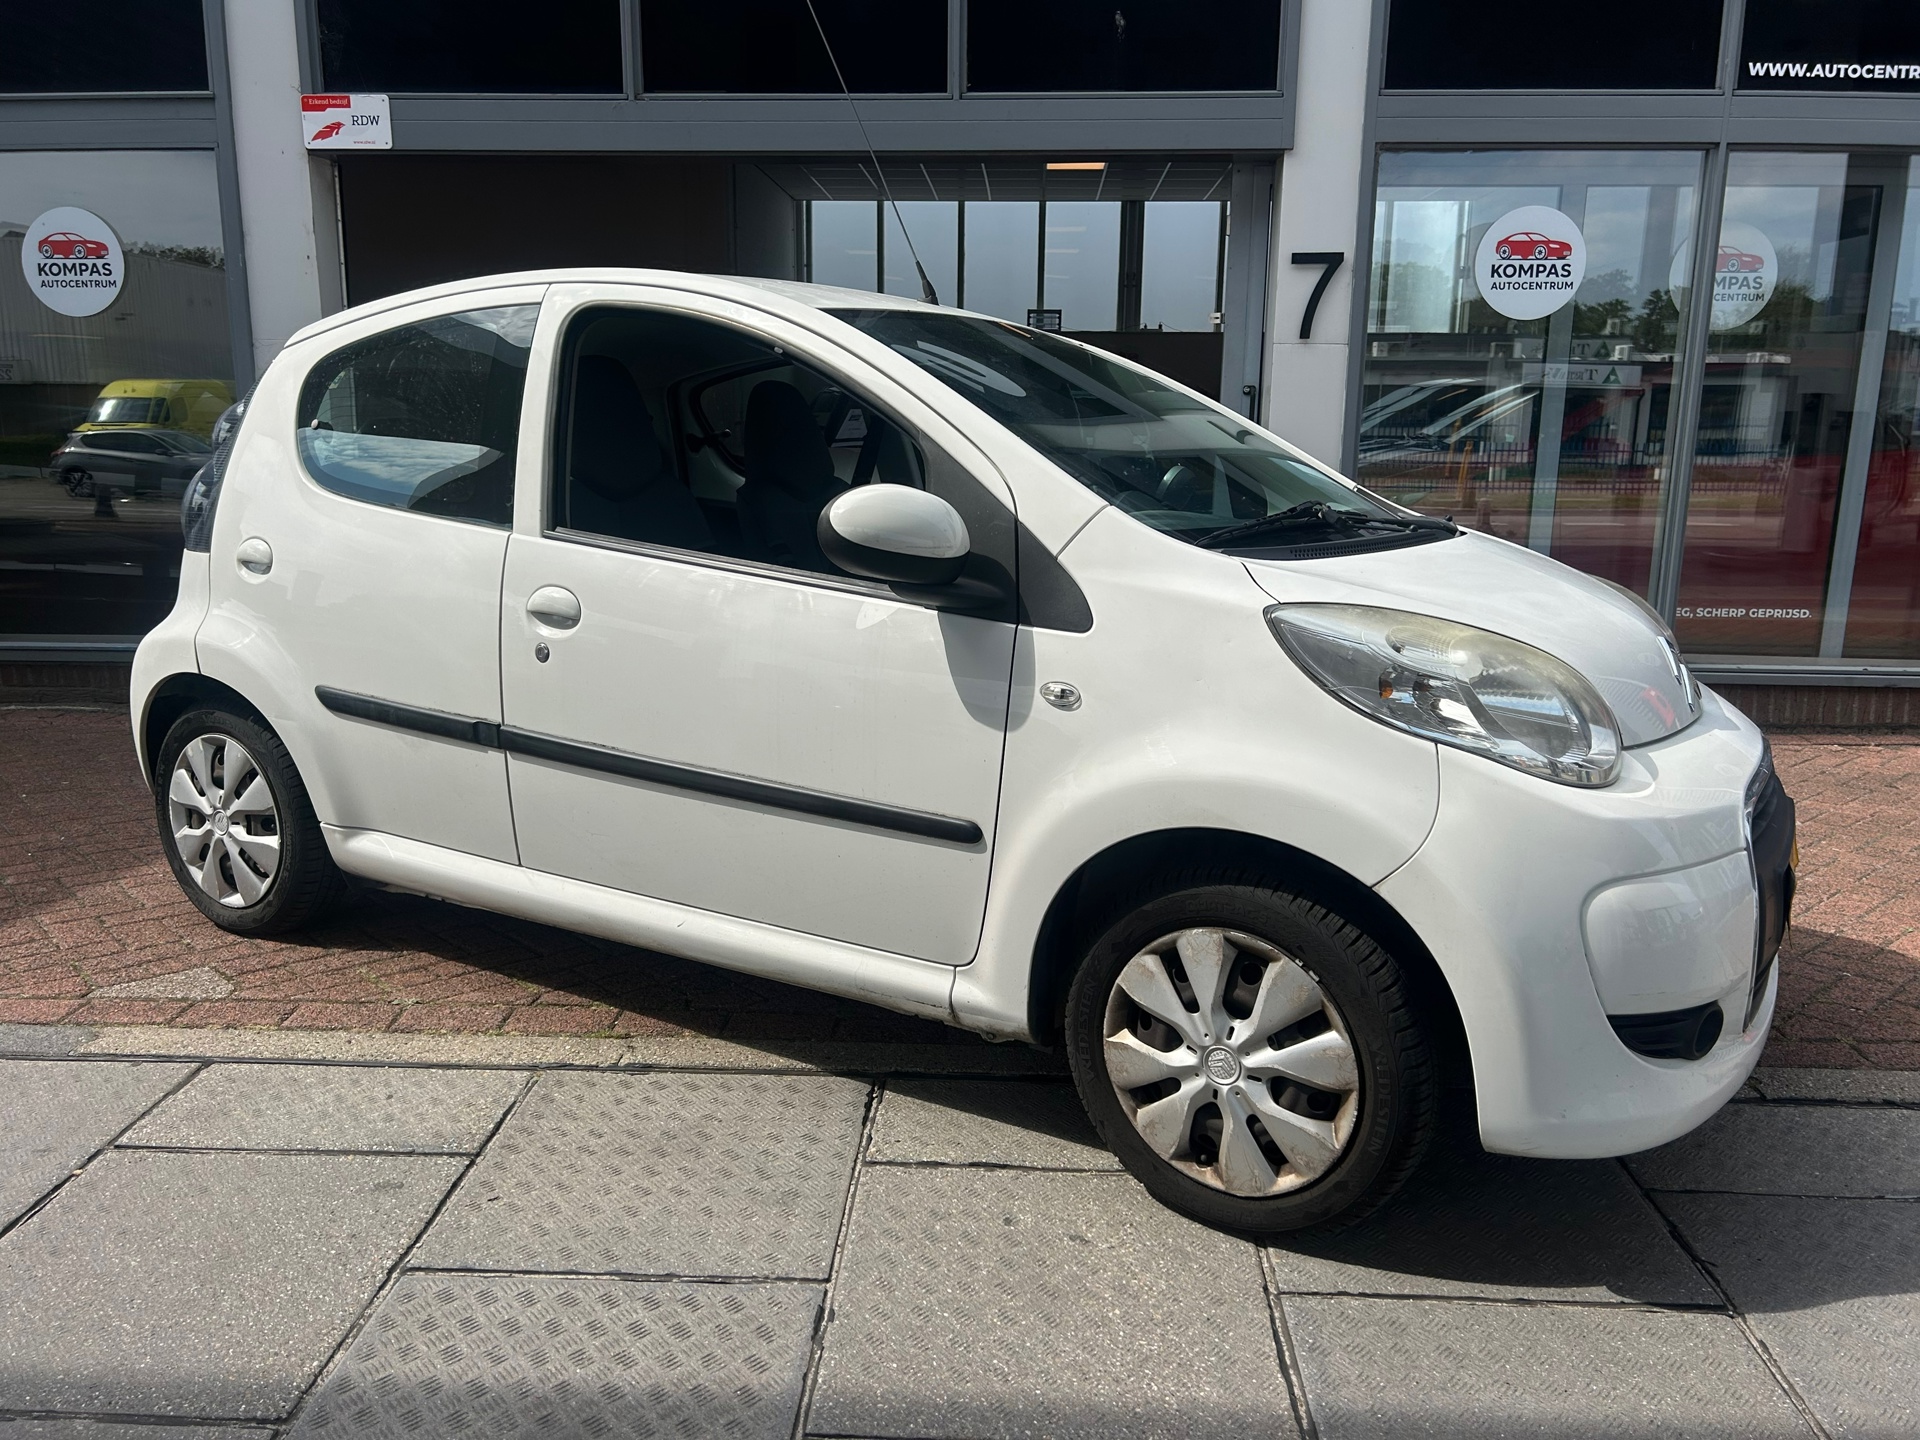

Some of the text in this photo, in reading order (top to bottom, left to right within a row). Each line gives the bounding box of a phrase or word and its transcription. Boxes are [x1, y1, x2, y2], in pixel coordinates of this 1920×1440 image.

[1748, 62, 1920, 79] WWW.AUTOCENTR
[330, 98, 348, 106] bedrijf
[351, 115, 380, 126] RDW
[37, 263, 113, 277] KOMPAS
[1490, 263, 1572, 279] KOMPAS
[40, 280, 117, 288] AUTOCENTRUM
[1490, 281, 1574, 291] AUTOCENTRUM
[1714, 276, 1763, 290] MPAS
[1291, 252, 1345, 340] 7
[1713, 293, 1765, 302] CENTRUM
[1696, 607, 1746, 618] SCHERP
[1749, 608, 1812, 618] GEPRIJSD.
[1077, 975, 1098, 1085] VREDESTEIN
[1369, 1042, 1393, 1155] VREDESTEIN
